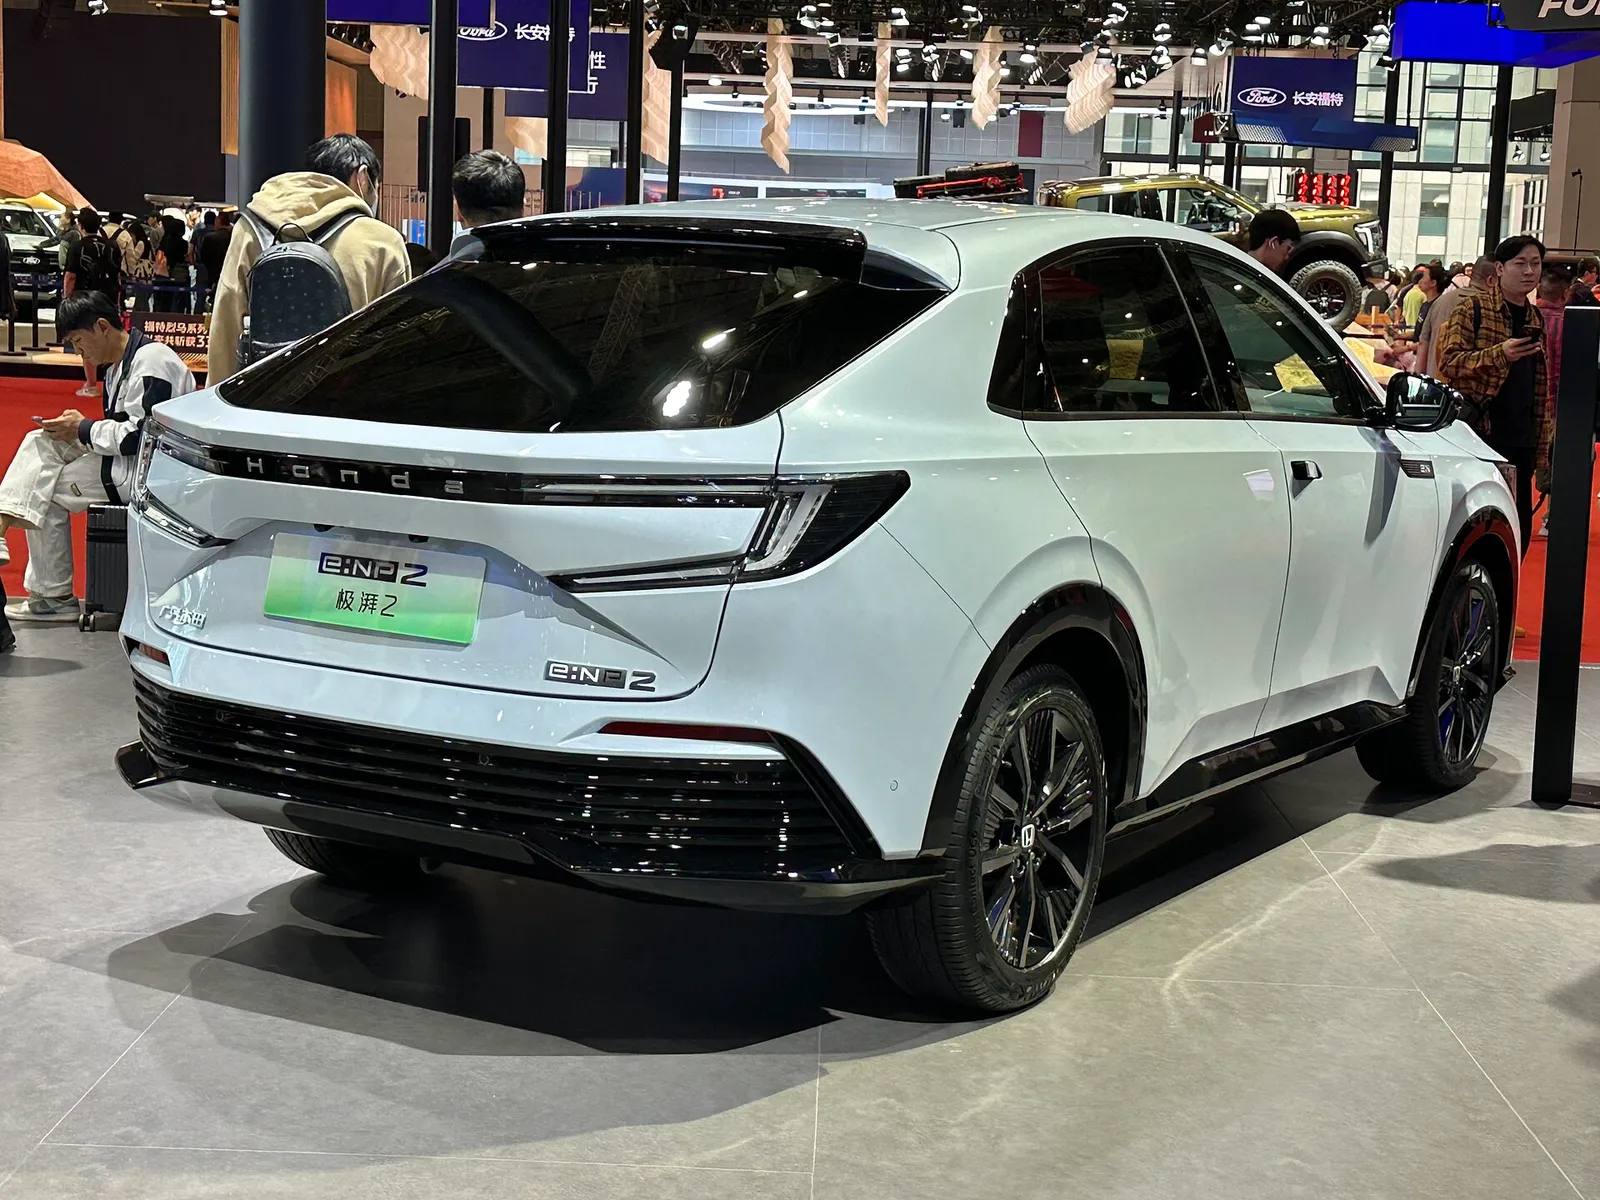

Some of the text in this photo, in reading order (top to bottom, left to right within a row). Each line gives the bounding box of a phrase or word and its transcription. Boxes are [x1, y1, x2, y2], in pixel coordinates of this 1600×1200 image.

[1538, 0, 1600, 17] FO
[1245, 89, 1279, 105] Ford
[1292, 91, 1344, 106] 长安福特
[143, 320, 208, 334] 福特烈马系列
[246, 456, 464, 494] Honda
[335, 588, 398, 617] 极湃2
